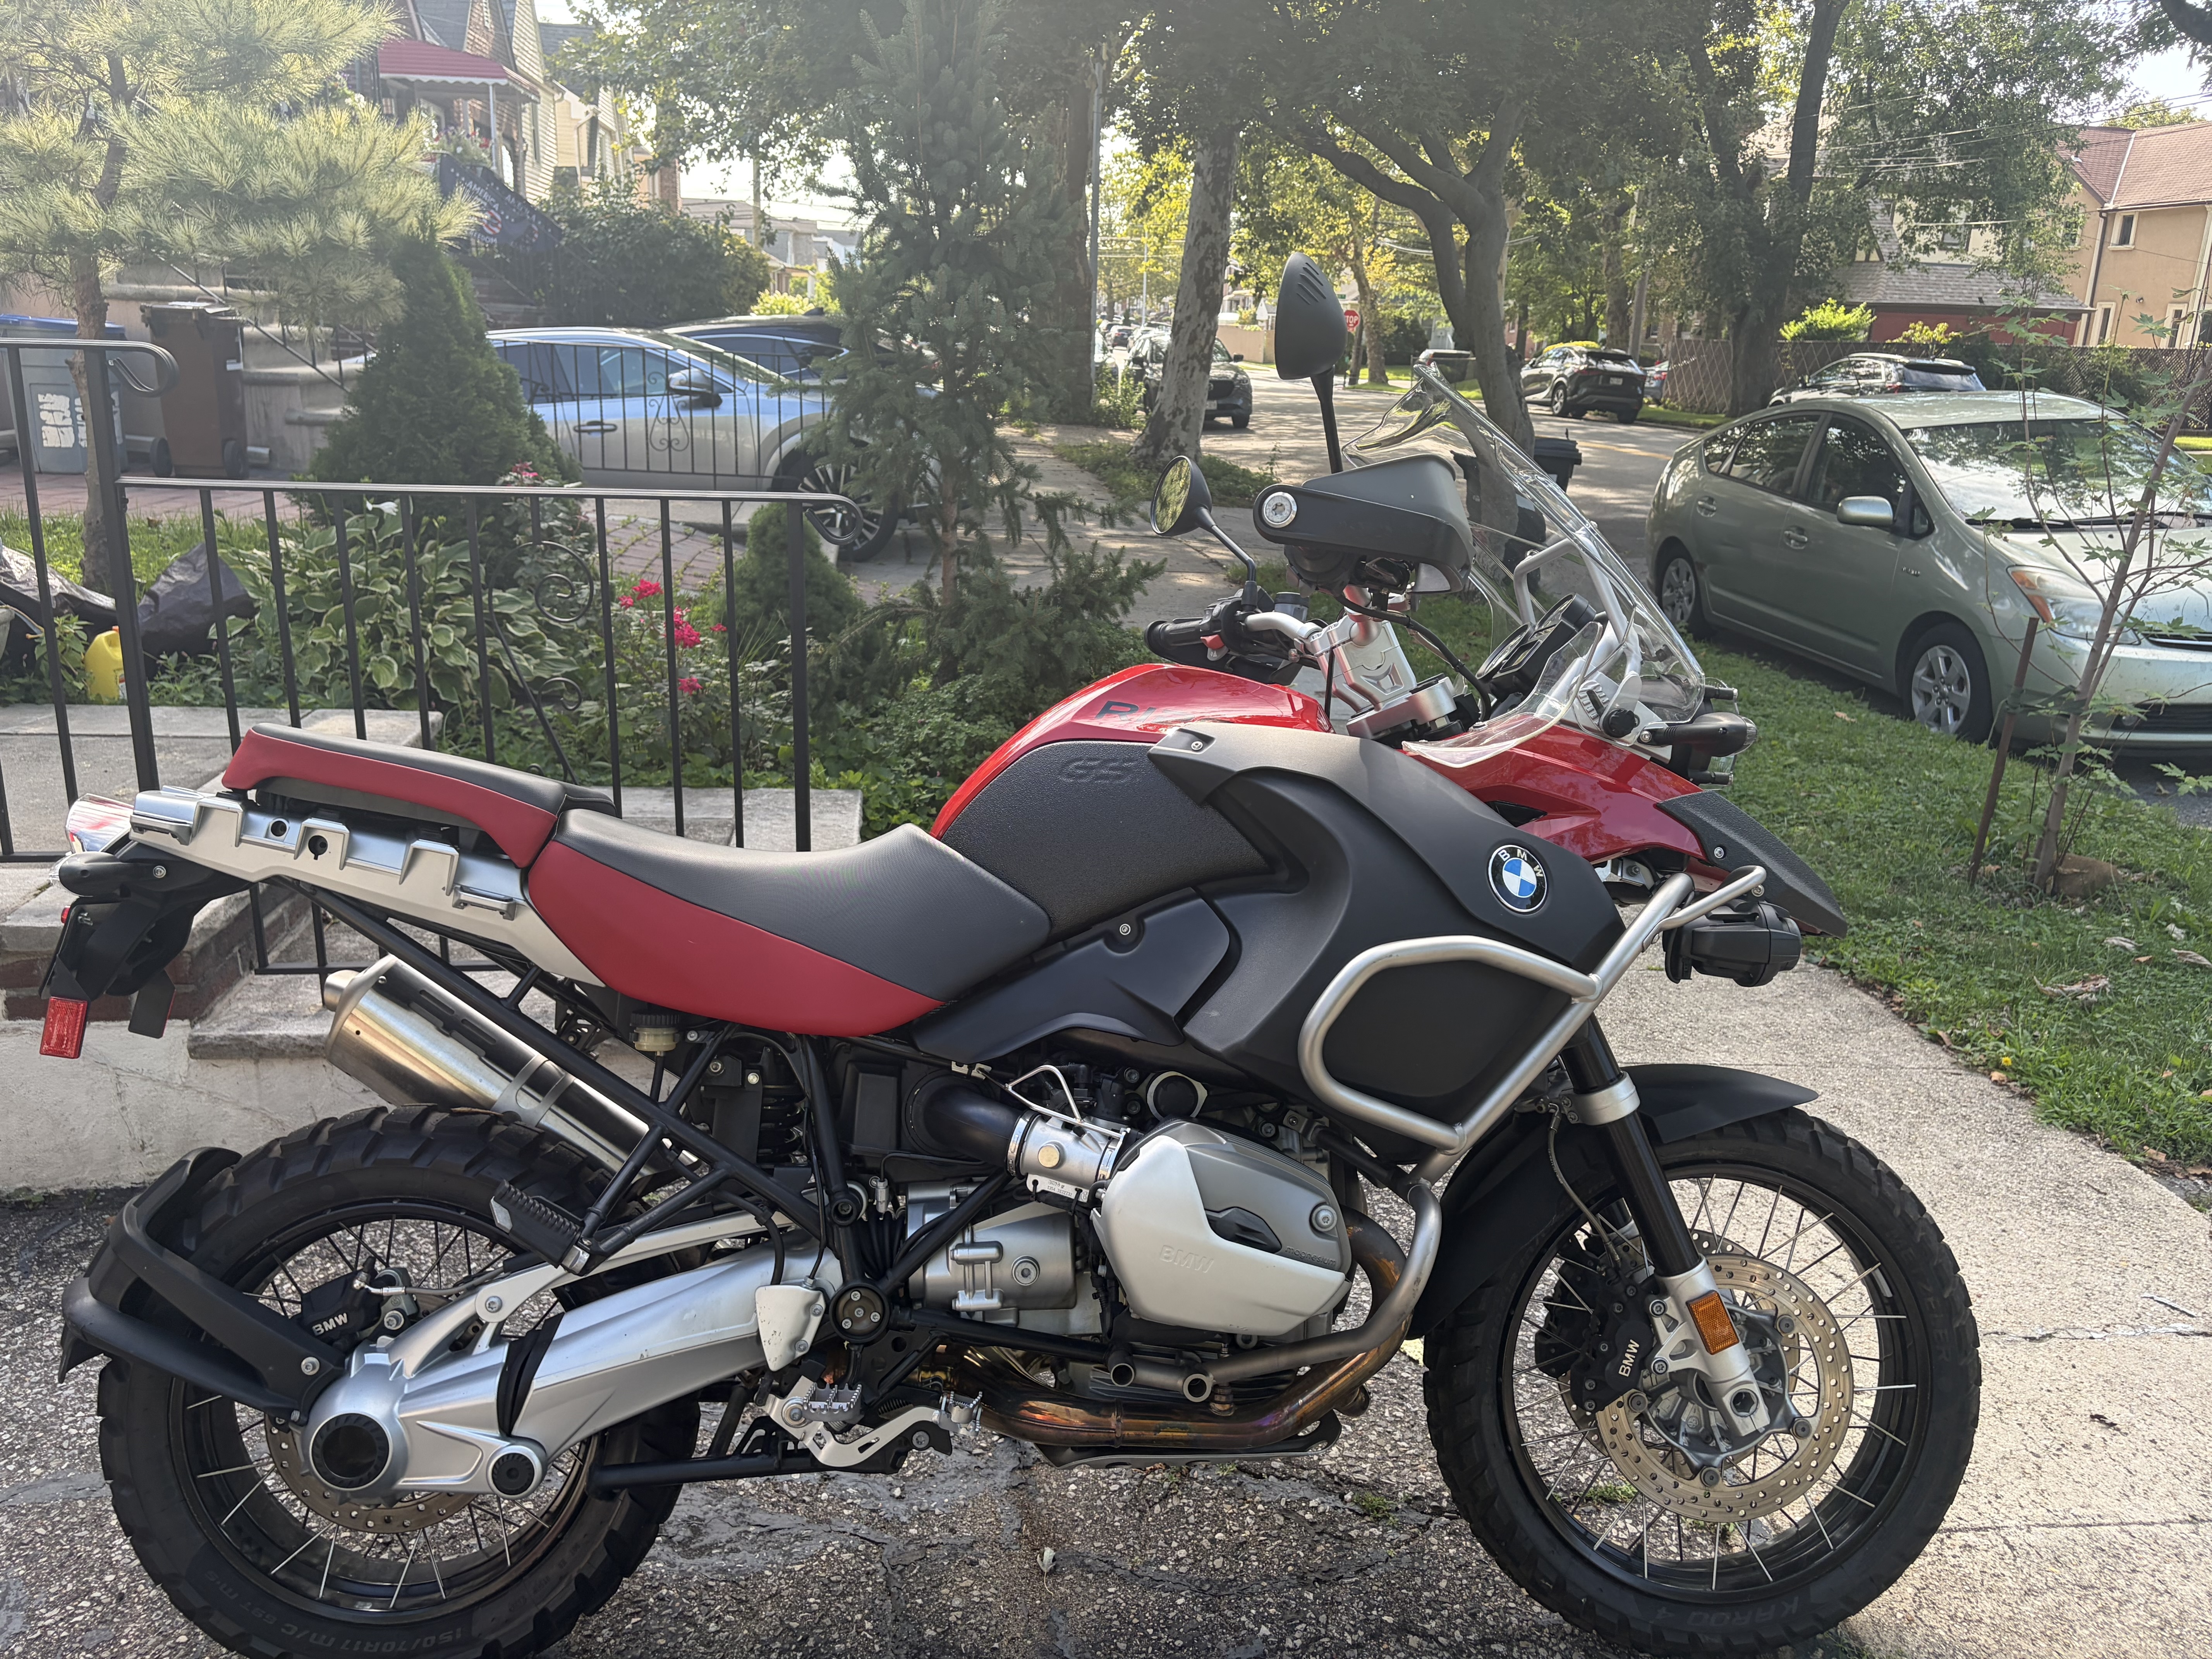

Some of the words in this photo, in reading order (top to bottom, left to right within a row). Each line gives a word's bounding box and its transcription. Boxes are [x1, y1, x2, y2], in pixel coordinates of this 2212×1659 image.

[466, 180, 500, 212] AMERICA
[1345, 315, 1358, 324] TOP
[1498, 848, 1544, 877] BMW
[1159, 1245, 1214, 1273] BMW
[1285, 1246, 1336, 1267] magnesium
[312, 1312, 348, 1336] BMW
[1618, 1338, 1640, 1377] BMW
[1686, 1596, 1799, 1627] KAROO
[281, 1623, 336, 1647] M/C
[343, 1628, 462, 1652] 150/70R17
